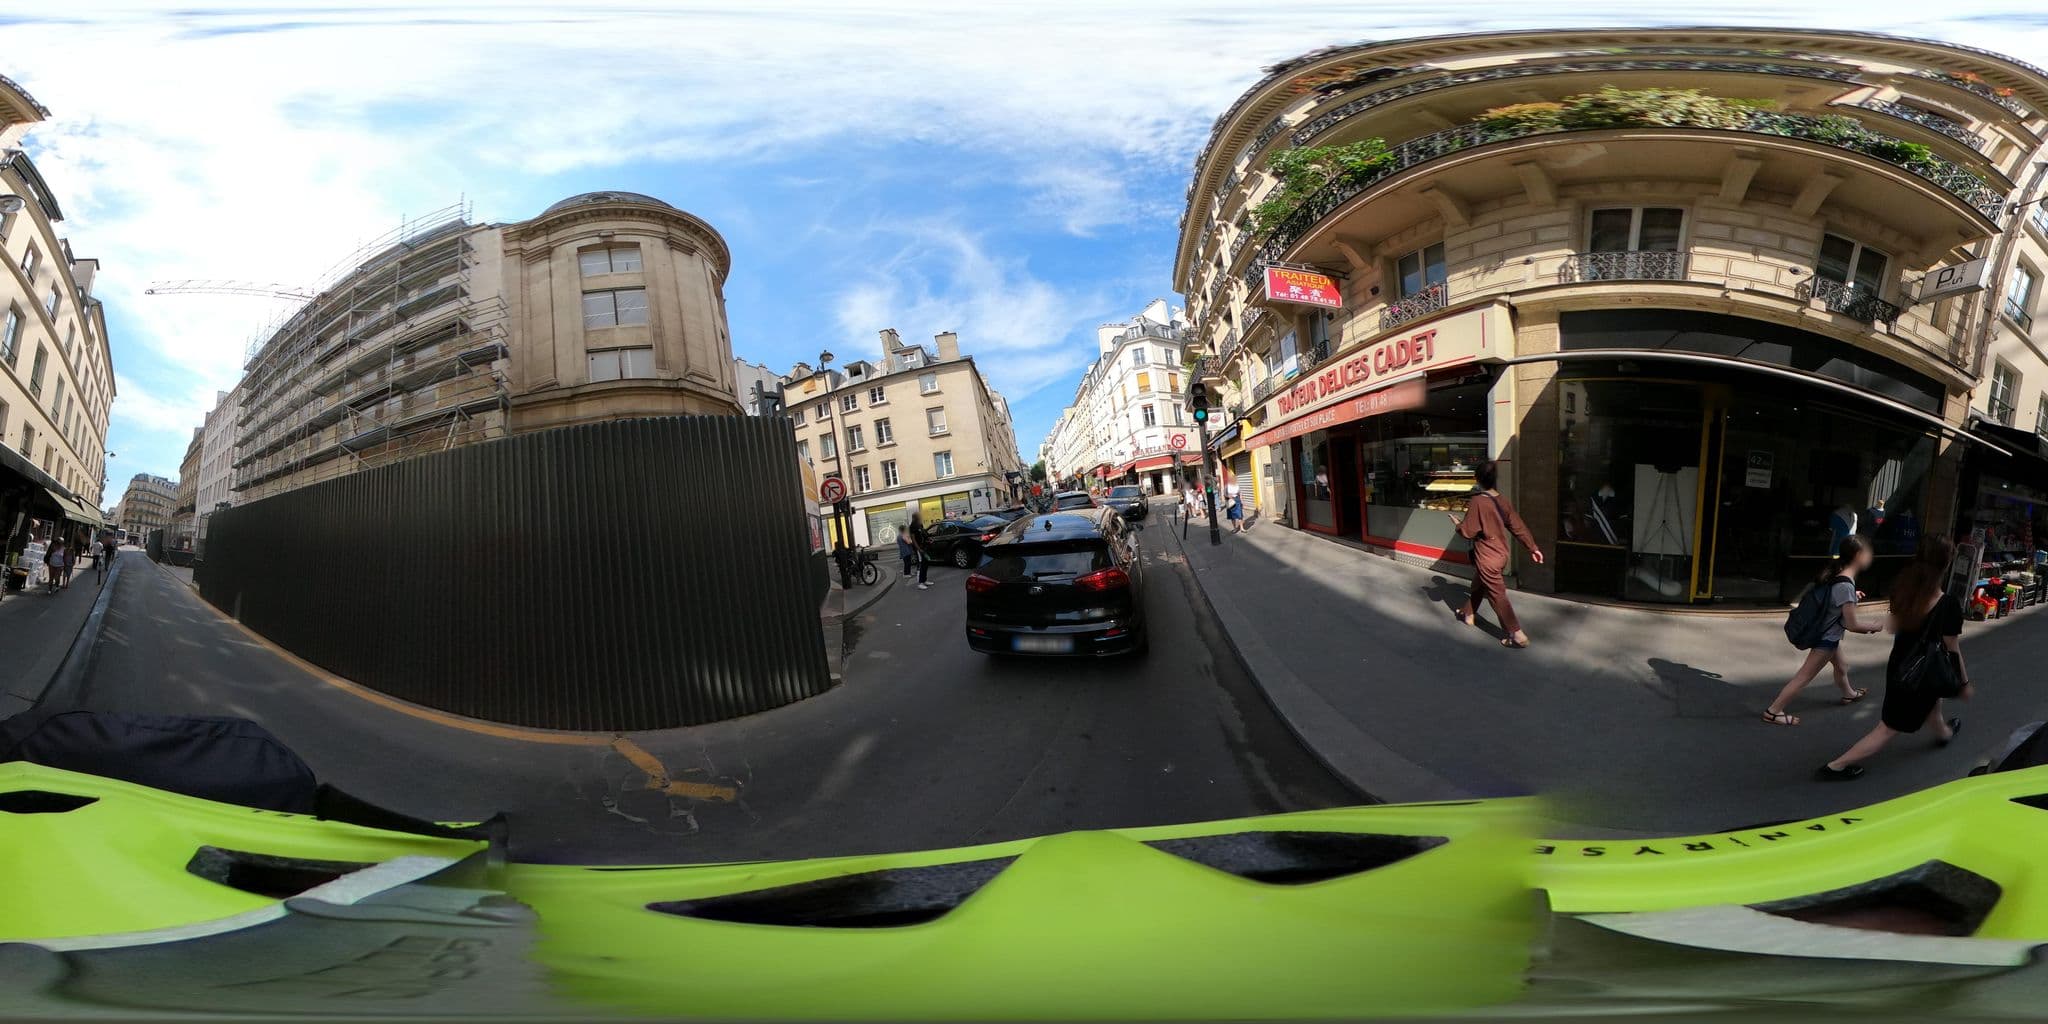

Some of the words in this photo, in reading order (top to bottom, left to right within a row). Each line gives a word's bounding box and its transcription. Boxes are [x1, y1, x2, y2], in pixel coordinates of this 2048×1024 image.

[1286, 280, 1325, 290] ASIATIQUE
[1277, 382, 1318, 416] TRAITEUR
[1318, 355, 1370, 398] DELICES
[1374, 329, 1437, 376] CADET
[1318, 409, 1335, 424] PLACE
